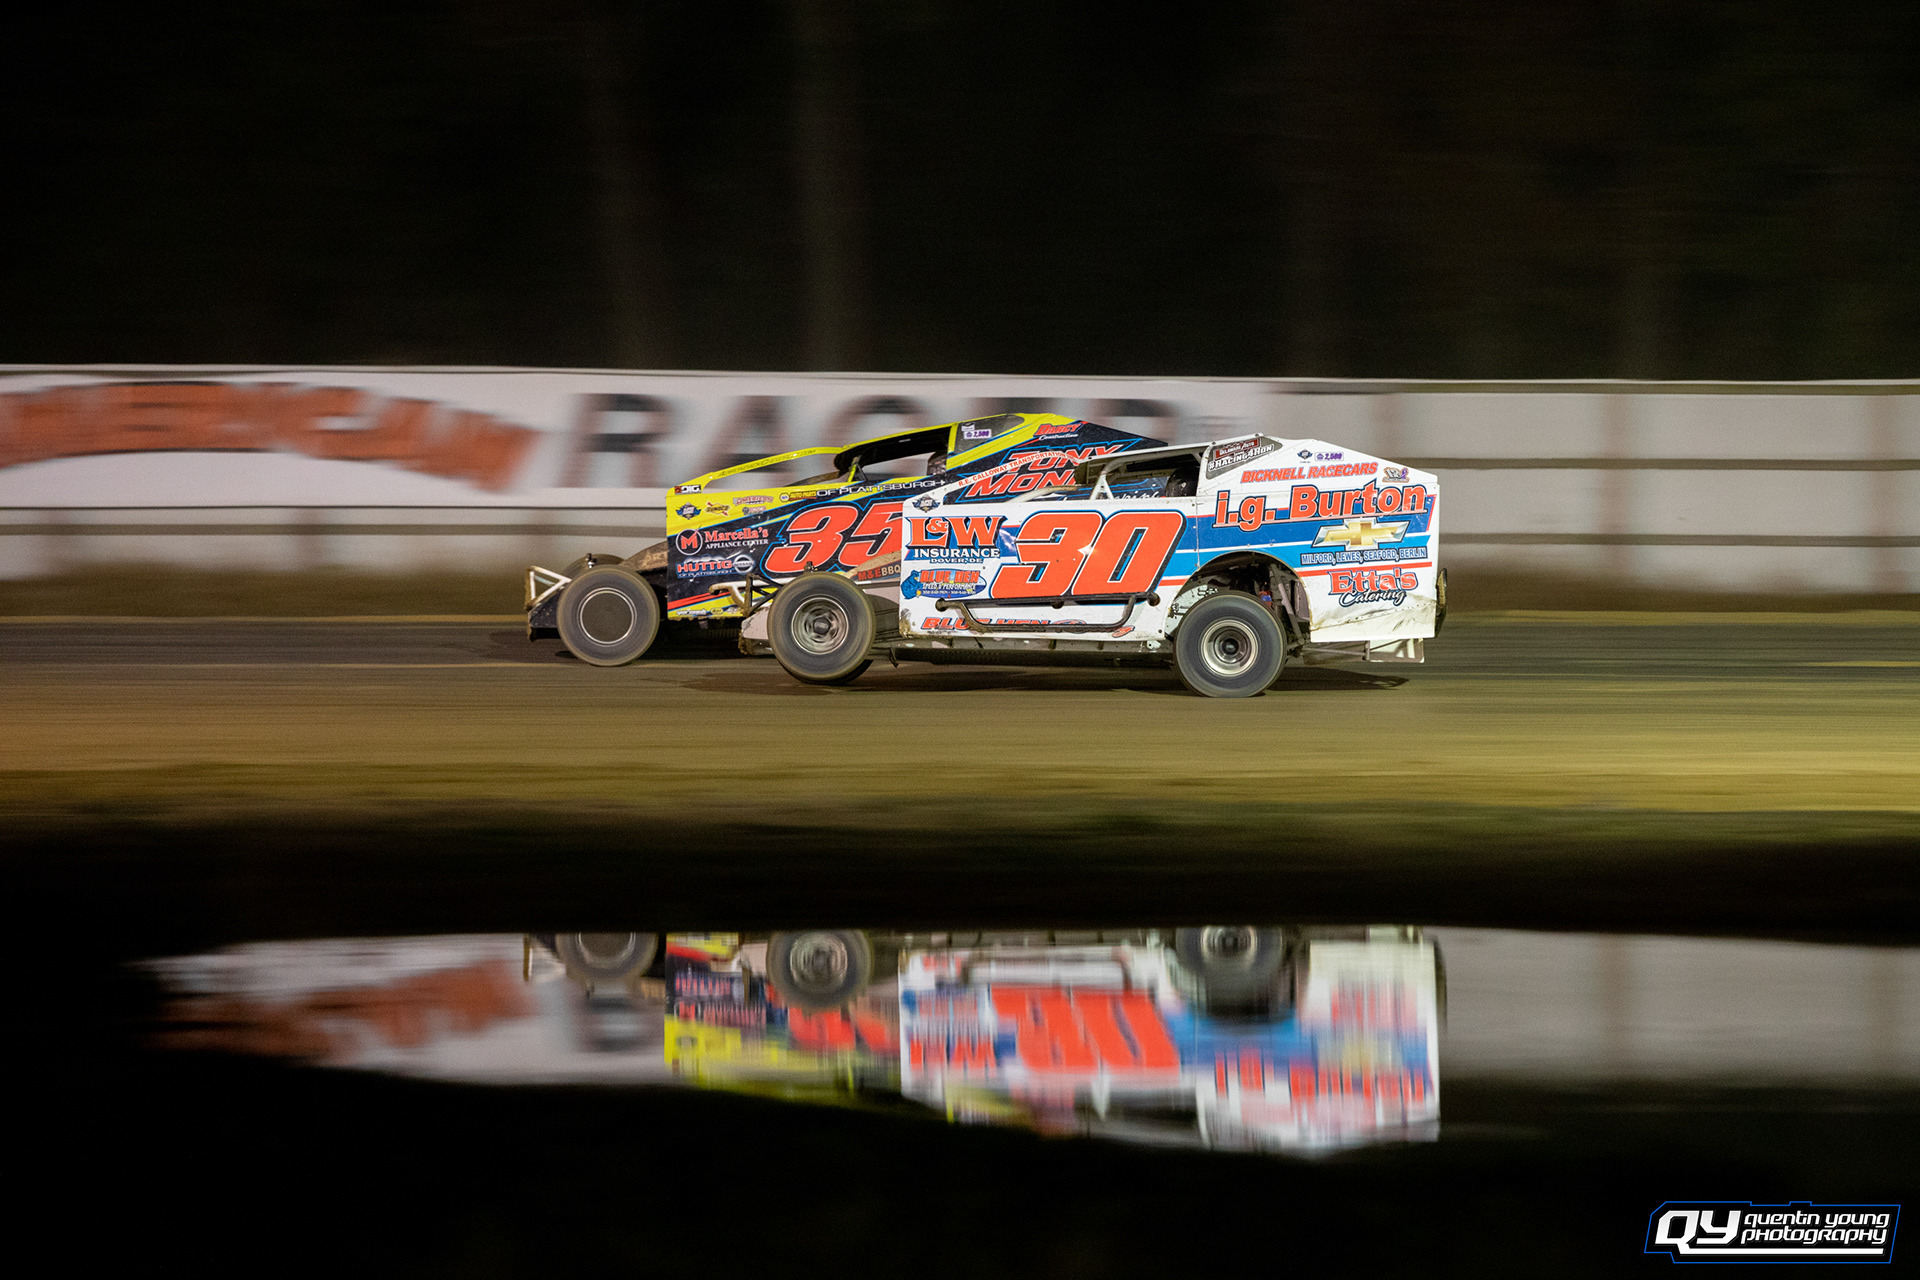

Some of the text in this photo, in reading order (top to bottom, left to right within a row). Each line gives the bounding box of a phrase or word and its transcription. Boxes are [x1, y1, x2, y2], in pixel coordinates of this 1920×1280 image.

[1038, 432, 1079, 441] Construction
[973, 465, 1008, 482] CALLOWAY
[1008, 451, 1067, 468] TRANSPORTATION
[1240, 466, 1307, 484] BICKNELL
[1308, 462, 1379, 479] RACECARS
[816, 488, 836, 497] OF
[838, 480, 947, 495] PLATTSBURGH
[1213, 478, 1428, 532] i.g. Burton
[704, 526, 769, 543] Marcella's
[765, 501, 903, 573] 35
[906, 516, 1006, 549] L&W
[705, 538, 769, 549] APPLIANCE CENTER
[913, 548, 1001, 558] INSURANCE
[990, 511, 1185, 599] 30
[1301, 546, 1428, 566] MILFORD, LEWES, SEAFORD, BERLIN
[920, 570, 980, 583] BLUE HEN
[1328, 567, 1419, 596] Etta's
[1338, 590, 1407, 607] Catering
